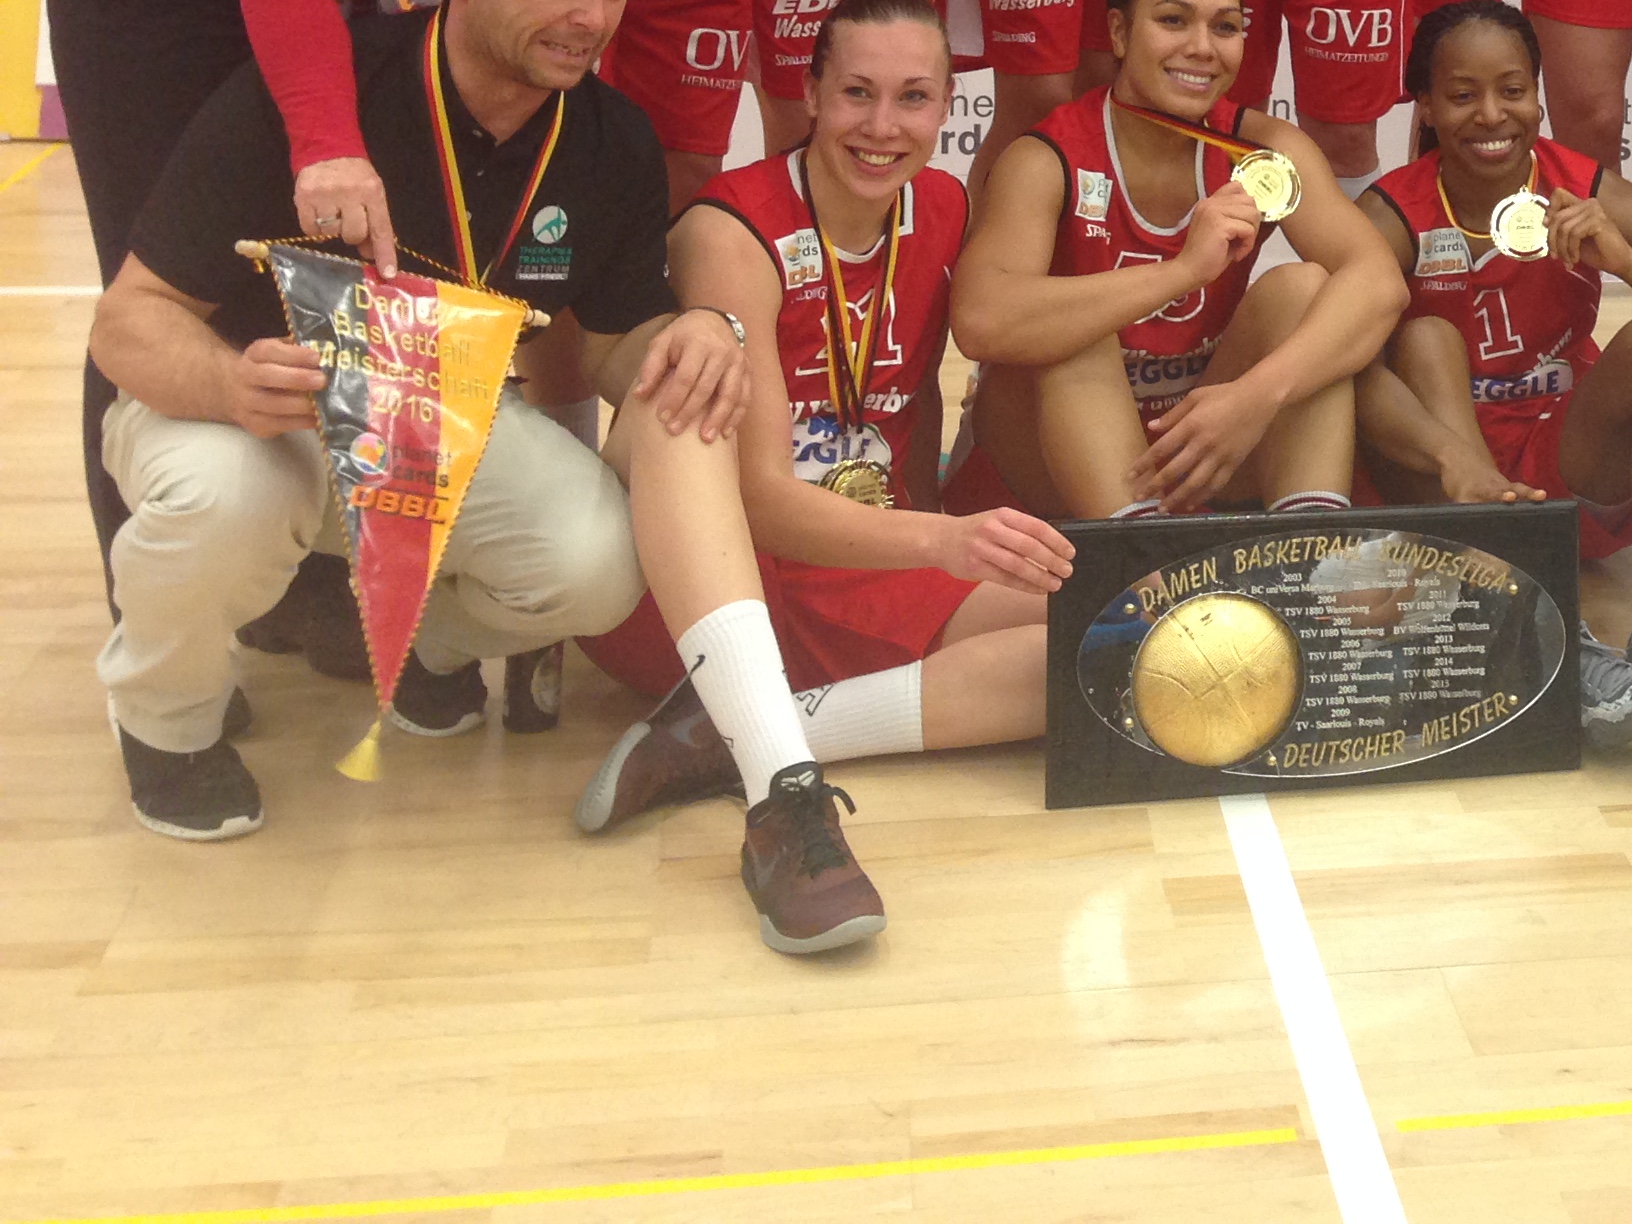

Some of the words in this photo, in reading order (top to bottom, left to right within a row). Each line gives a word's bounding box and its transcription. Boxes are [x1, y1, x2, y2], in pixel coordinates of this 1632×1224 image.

[1305, 6, 1394, 48] OVB
[1433, 241, 1464, 253] cards
[1419, 258, 1467, 275] DBBL
[1473, 287, 1525, 361] 1
[371, 385, 435, 424] 2016
[393, 443, 453, 468] planet
[394, 463, 449, 489] cards
[350, 484, 448, 525] DBBL
[1137, 556, 1220, 613] DAMEN
[1232, 535, 1362, 575] BASKETBALL
[1379, 540, 1508, 595] BUNDESLIGA
[1250, 585, 1265, 595] BC
[1396, 601, 1416, 611] TSV
[1285, 607, 1303, 617] TSV
[1300, 628, 1318, 639] TSV
[1393, 625, 1407, 635] BV
[1308, 651, 1327, 661] TSV
[1402, 646, 1421, 656] TSV
[1309, 673, 1328, 683] TSV
[1403, 669, 1421, 679] TSV
[1399, 691, 1417, 701] TSV
[1305, 697, 1324, 707] TSV
[1282, 729, 1407, 770] DEUTSCHER
[1421, 691, 1510, 748] MEISTER
[1296, 721, 1310, 731] TV
